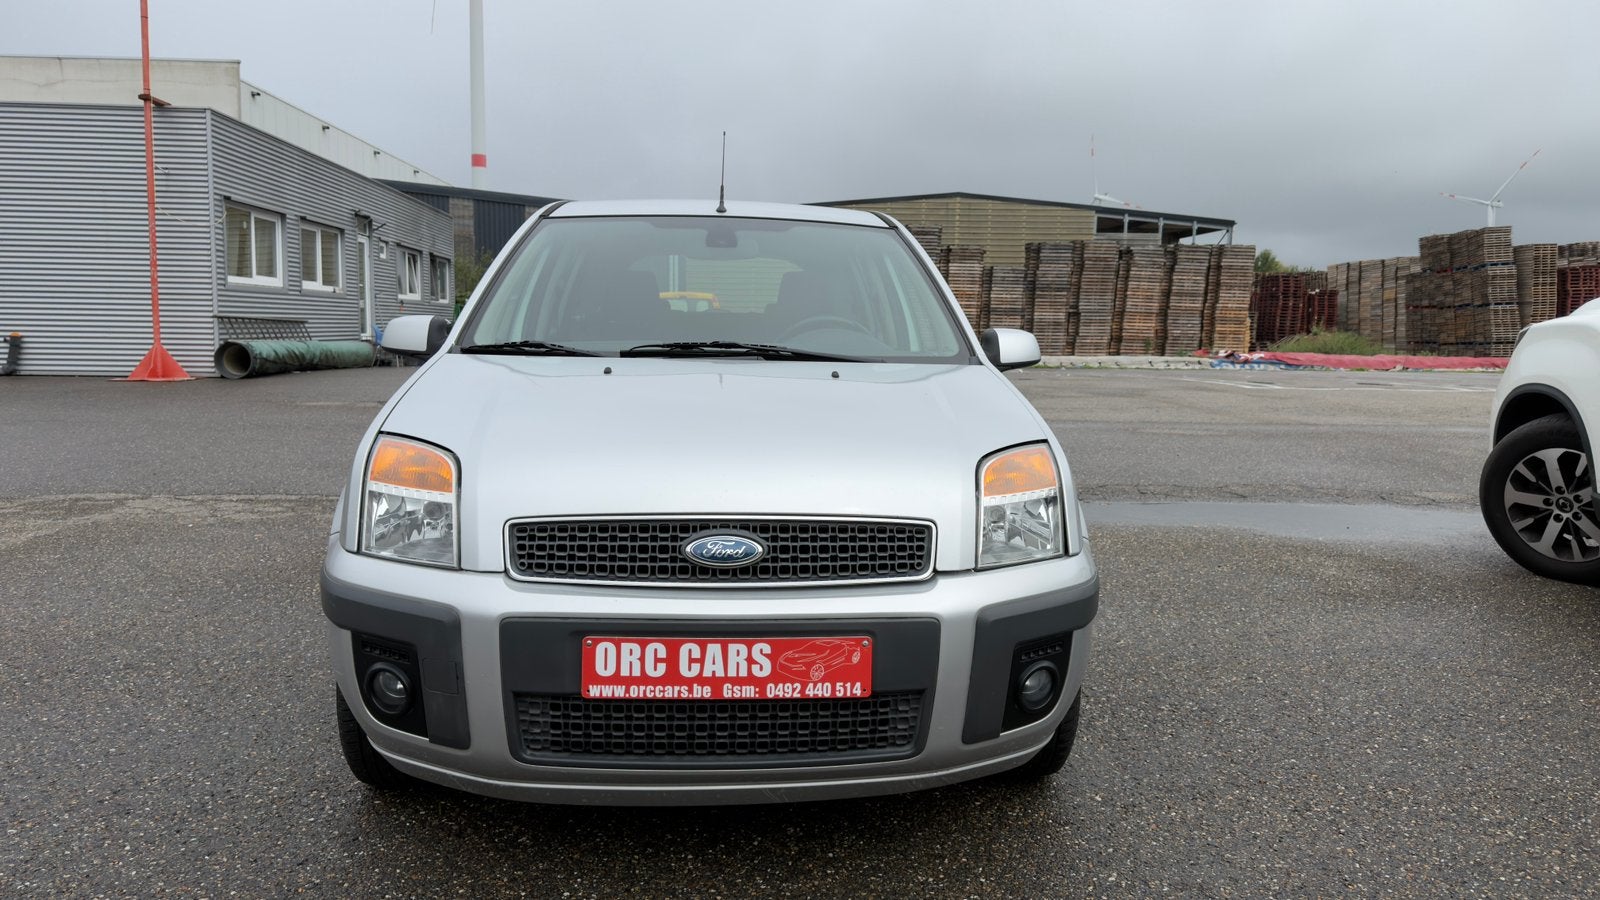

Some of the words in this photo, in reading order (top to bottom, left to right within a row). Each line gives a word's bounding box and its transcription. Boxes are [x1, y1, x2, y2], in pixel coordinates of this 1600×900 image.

[702, 540, 746, 558] Ford
[595, 641, 667, 677] ORC
[679, 642, 772, 678] CARS
[588, 683, 712, 698] www.orccars.be
[722, 683, 759, 698] Gsm:
[766, 683, 801, 698] 0492
[805, 682, 832, 698] 440
[835, 682, 862, 697] 514
